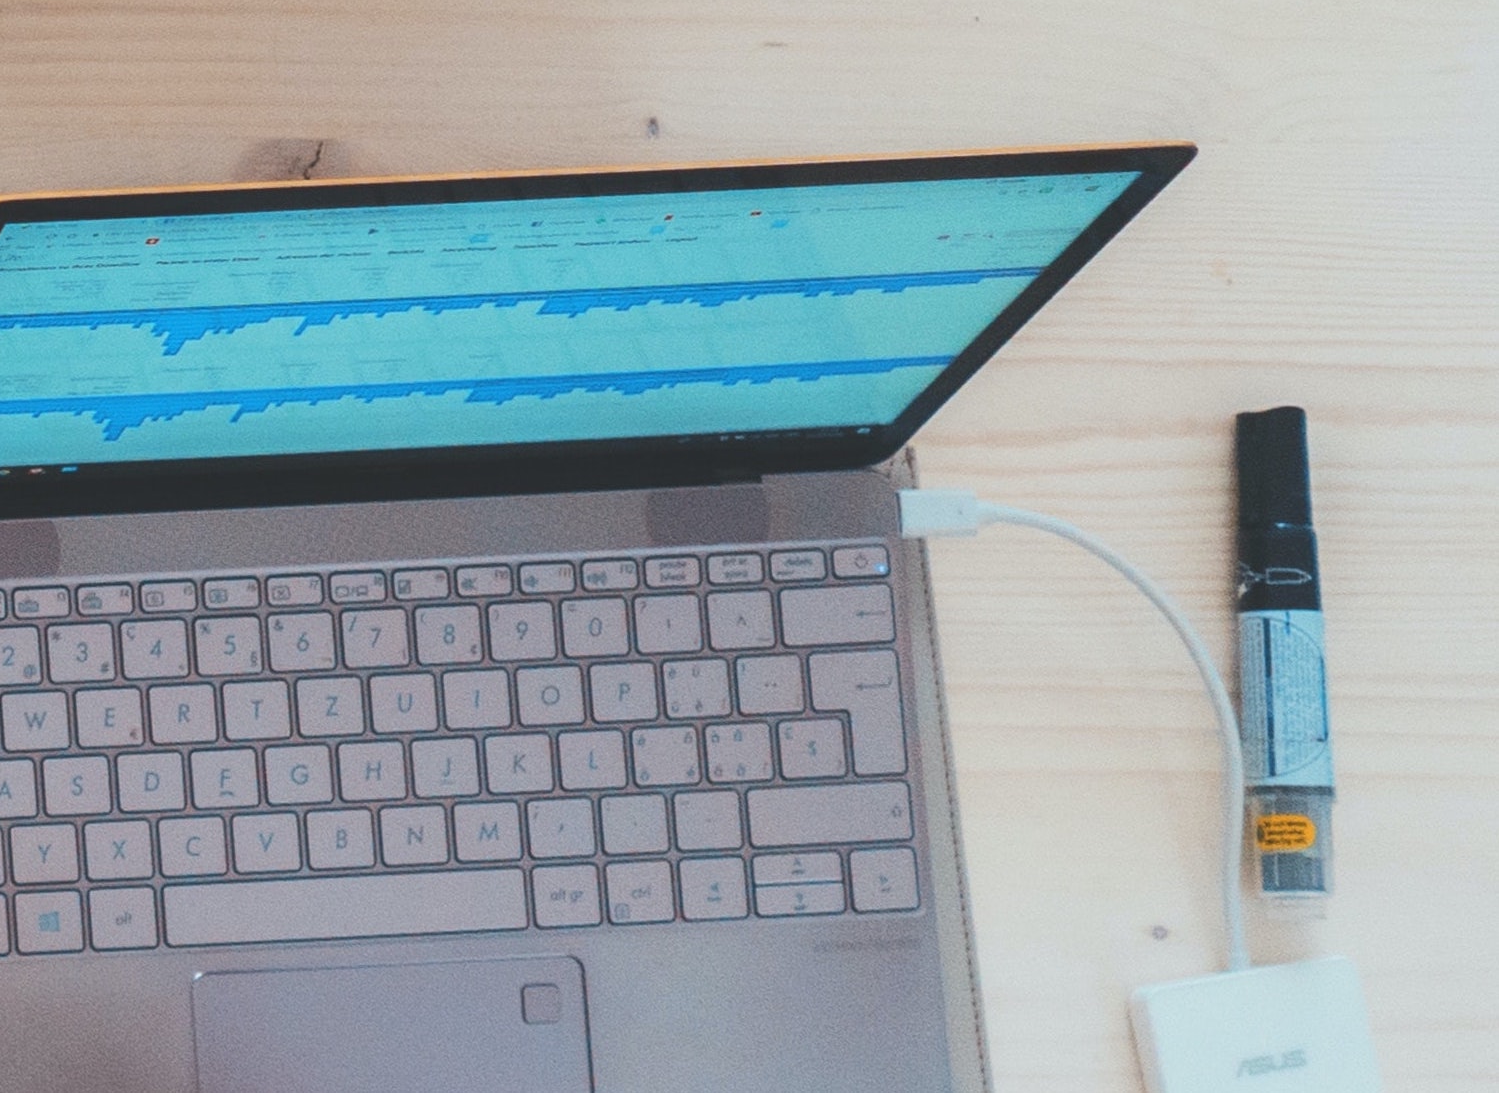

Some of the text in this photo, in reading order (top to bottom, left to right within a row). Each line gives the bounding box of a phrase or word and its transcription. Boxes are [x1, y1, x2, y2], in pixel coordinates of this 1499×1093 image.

[1, 644, 16, 668] 2
[74, 640, 90, 664] 3
[148, 637, 163, 660] 4
[222, 633, 237, 657] 5
[295, 631, 311, 653] 6
[369, 626, 383, 649] 7
[442, 623, 457, 646] 8
[514, 619, 530, 642] 9
[587, 616, 604, 638] 0
[23, 710, 48, 732] W
[103, 706, 116, 729] E
[176, 702, 191, 724] R
[250, 698, 264, 721] T
[324, 694, 340, 718] Z
[396, 692, 414, 714] U
[539, 684, 562, 707] O
[617, 681, 632, 703] P
[70, 774, 85, 797] S
[143, 770, 161, 793] D
[218, 767, 232, 790] F
[289, 763, 310, 786] G
[363, 759, 383, 782] H
[441, 756, 453, 778] J
[511, 753, 527, 775] K
[587, 749, 599, 771] L
[37, 821, 500, 865] Y X C V B N M
[1237, 1048, 1307, 1077] ASUS
